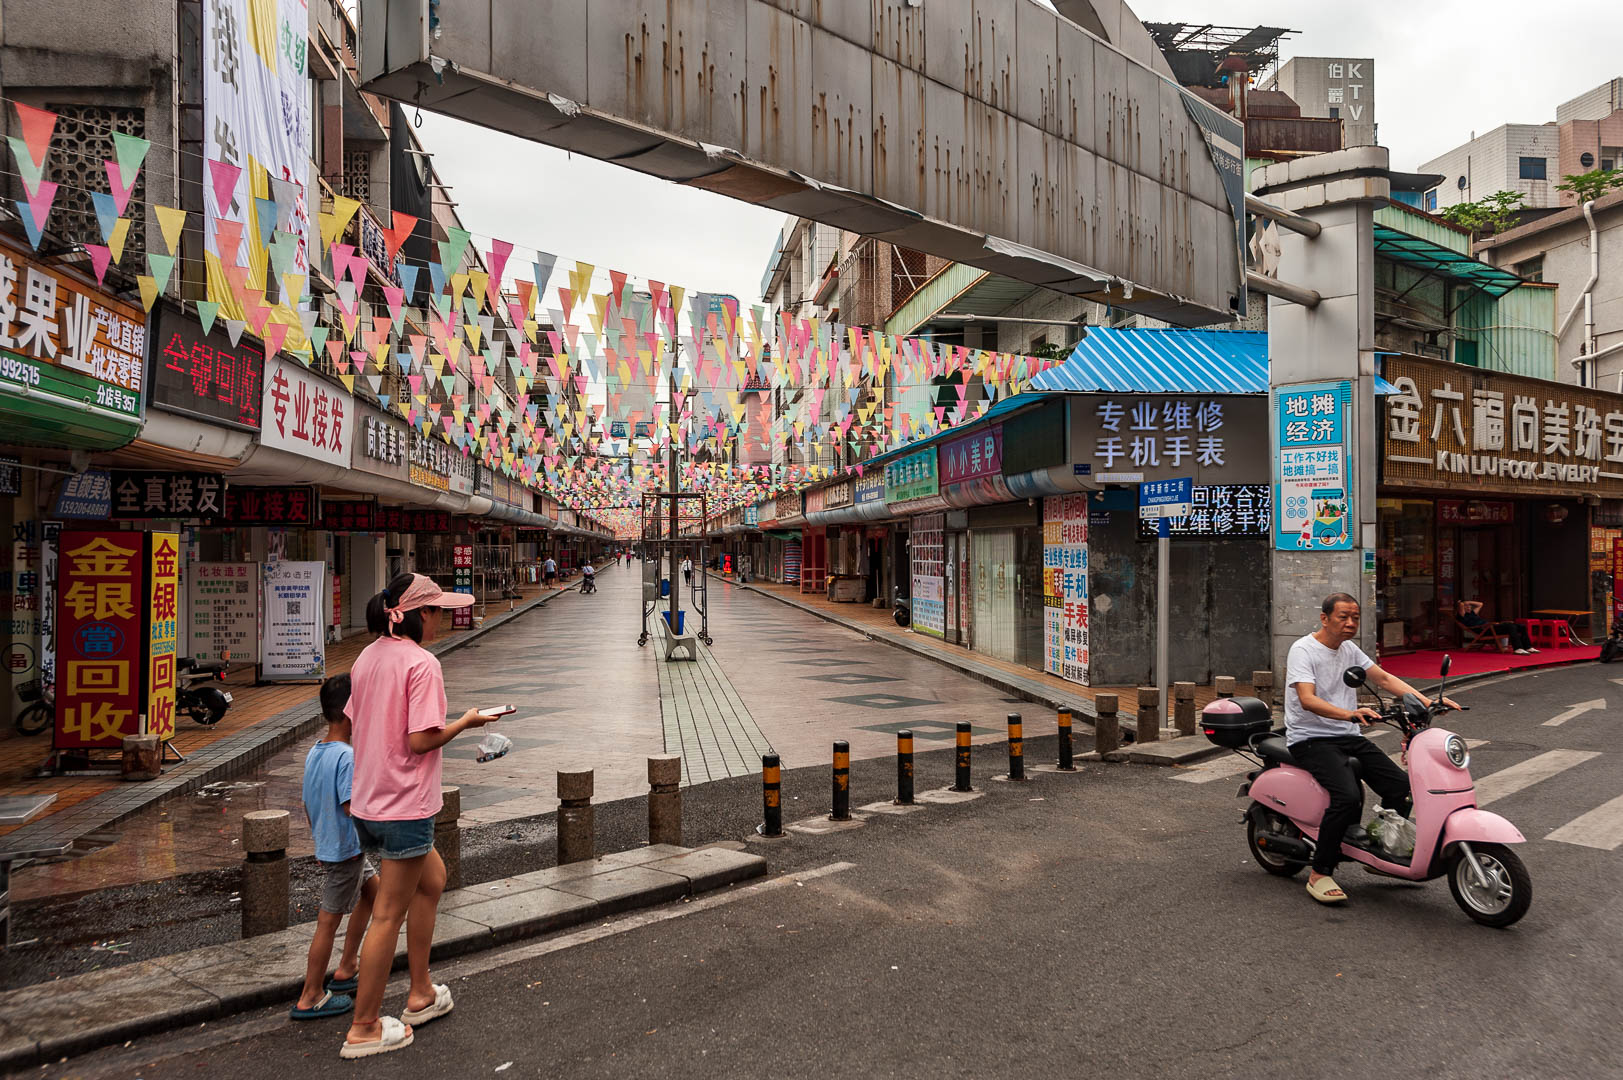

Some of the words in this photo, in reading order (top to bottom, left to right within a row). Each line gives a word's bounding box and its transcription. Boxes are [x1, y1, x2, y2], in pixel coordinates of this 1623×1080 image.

[1349, 63, 1363, 121] KTV
[94, 306, 145, 357] 产地直销
[0, 356, 40, 386] 992515
[91, 343, 142, 391] 批发零售
[96, 384, 136, 412] 分店号357
[271, 368, 344, 454] 专业接发
[1285, 393, 1335, 417] 地摊
[1096, 400, 1224, 432] 专业维修
[1286, 419, 1335, 442] 经济
[948, 436, 995, 478] 小小美甲
[1094, 435, 1225, 468] 手机手表
[1283, 450, 1339, 464] 工作不好找
[1283, 463, 1339, 477] 地摊搞一搞
[116, 475, 219, 513] 全真接发
[200, 566, 247, 577] 化妆造型
[454, 556, 472, 565] 接发
[1064, 548, 1088, 569] 专业维修
[64, 537, 138, 621] 金银
[153, 538, 177, 621] 金银
[1064, 573, 1088, 599] 手机
[1063, 602, 1088, 628] 手表
[81, 626, 116, 652] 當
[61, 660, 134, 742] 回收
[150, 653, 174, 736] 回收
